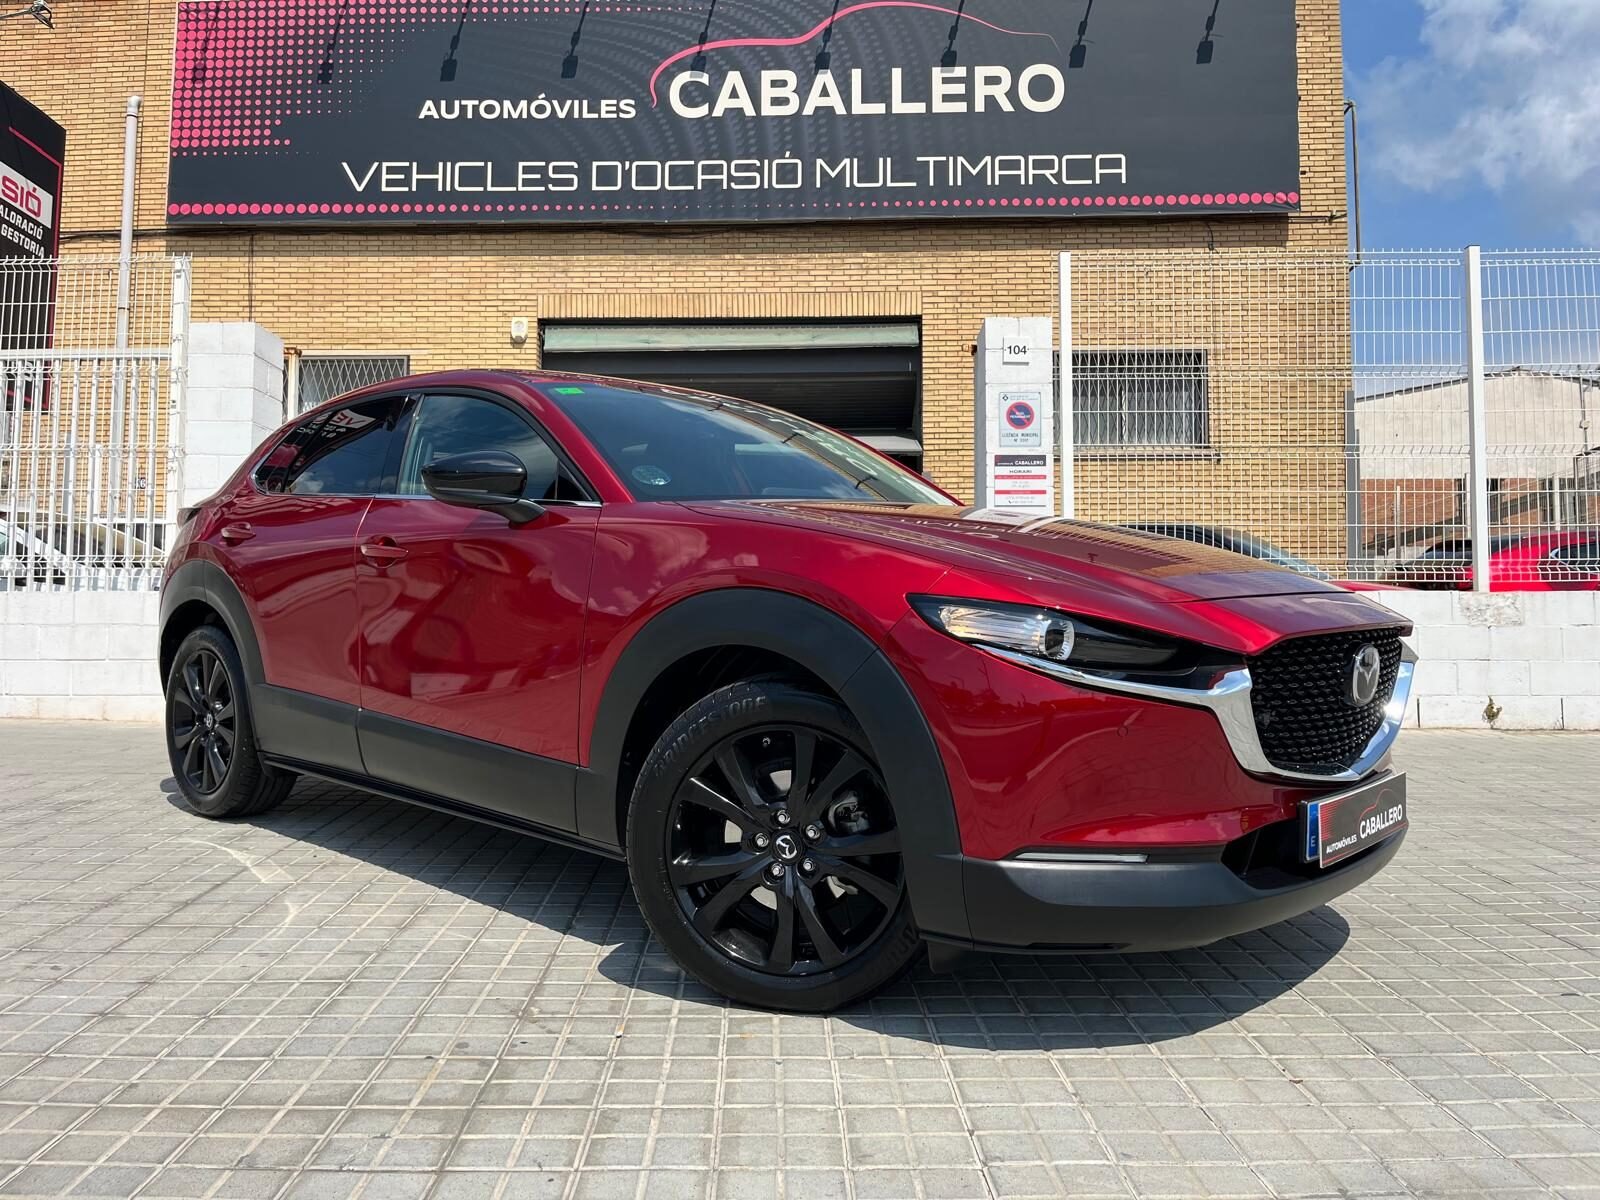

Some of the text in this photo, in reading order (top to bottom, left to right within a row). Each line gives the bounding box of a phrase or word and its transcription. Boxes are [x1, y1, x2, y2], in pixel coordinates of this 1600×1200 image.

[418, 64, 1065, 119] AUTOMÓVILES CABALLERO
[341, 152, 1126, 192] VEHICLES D'OCASIÓ MULTIMARCA
[1, 223, 45, 258] GESTORIA
[1007, 345, 1027, 355] 104
[1326, 804, 1403, 854] AUTOMÓVILES CABALLERO
